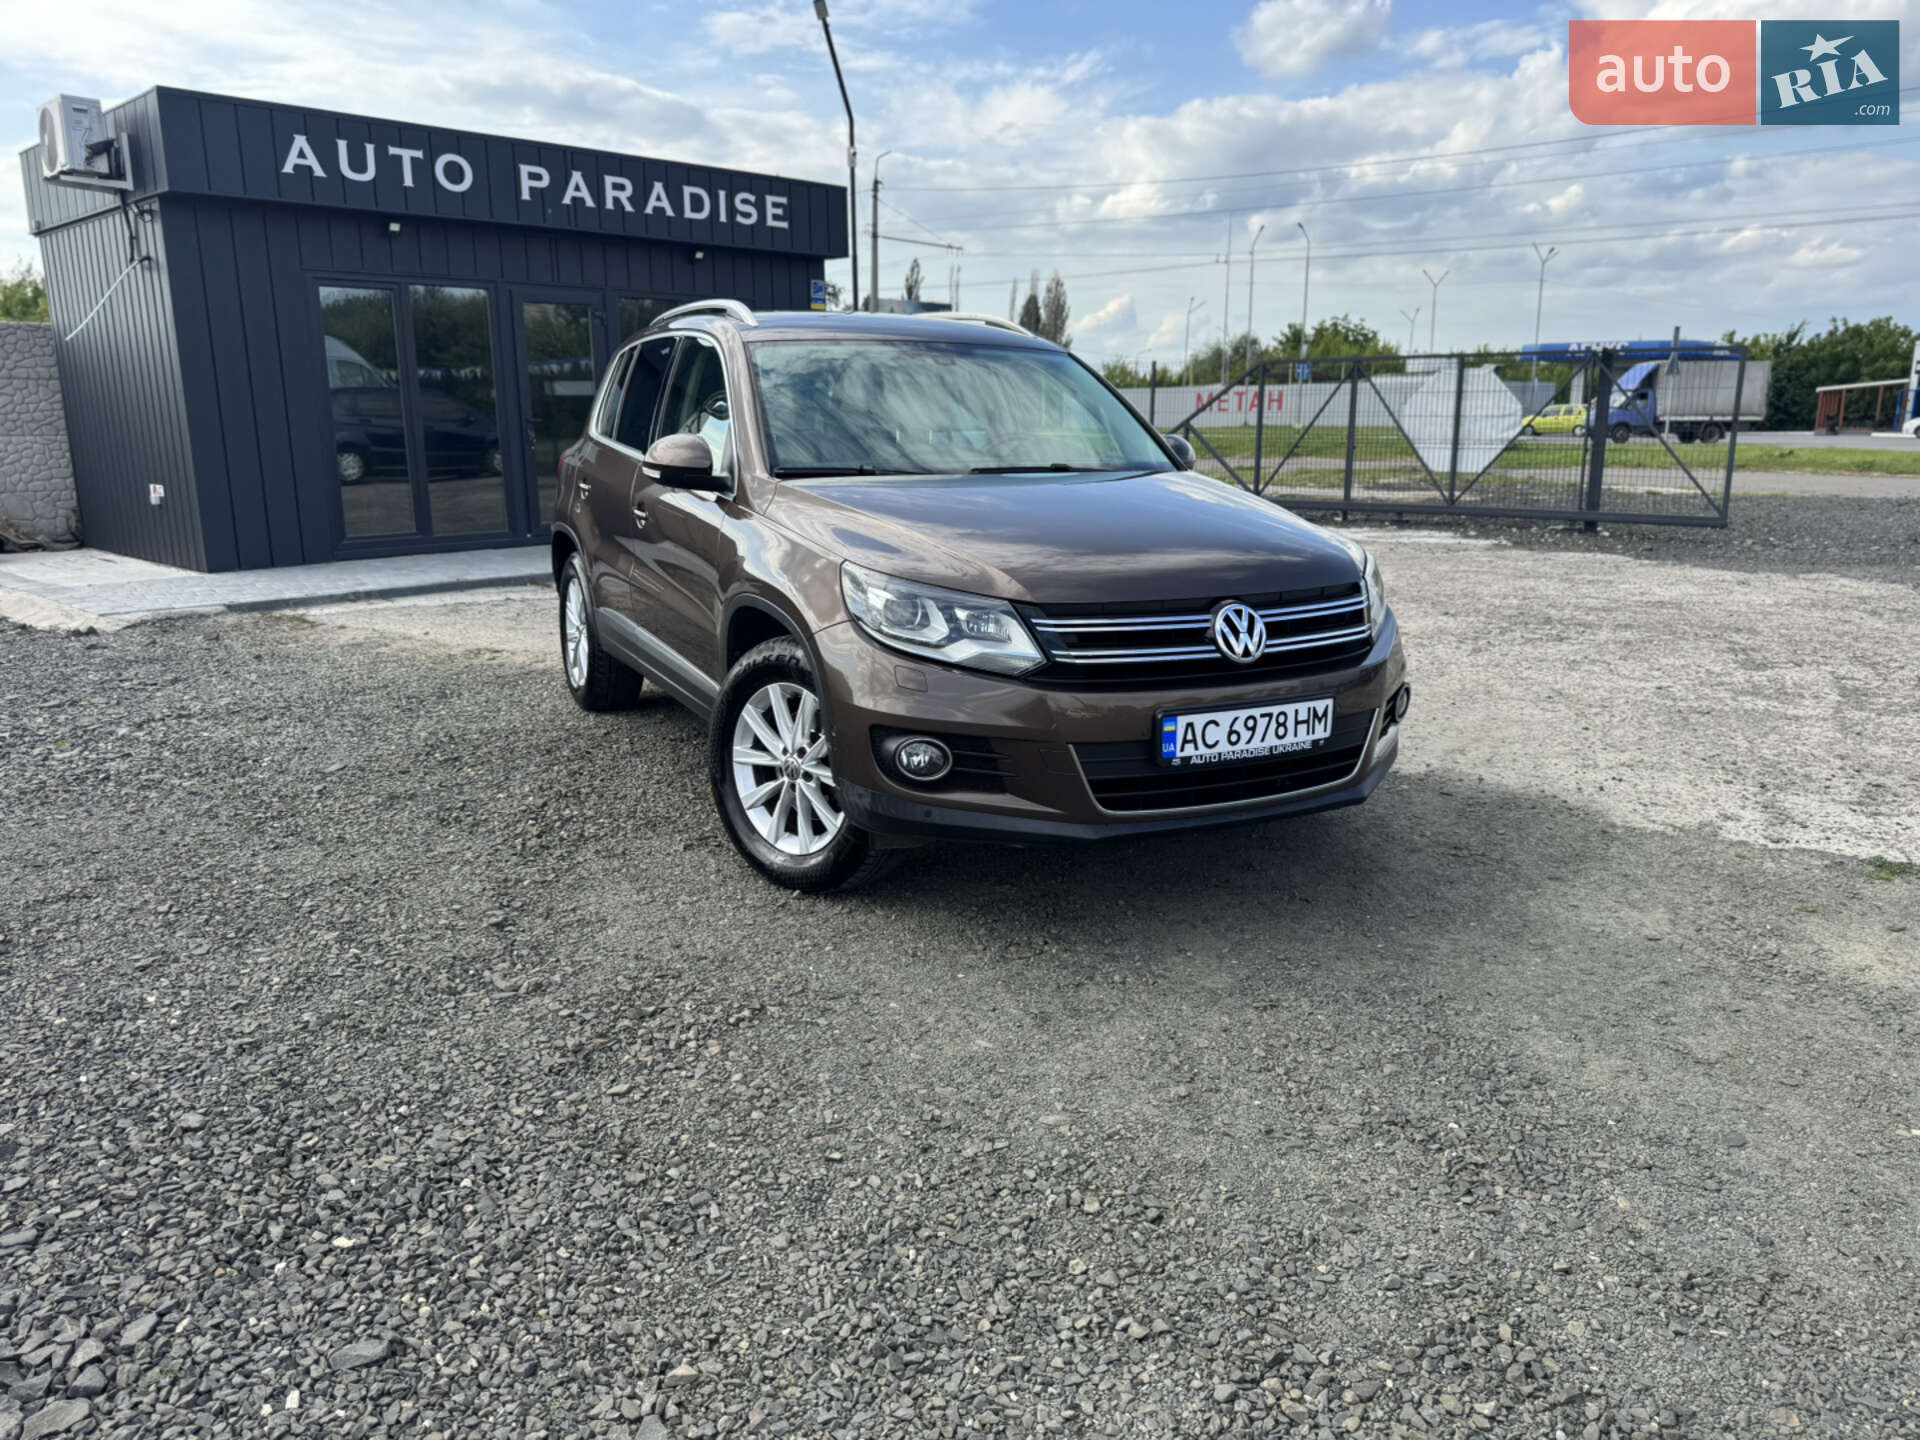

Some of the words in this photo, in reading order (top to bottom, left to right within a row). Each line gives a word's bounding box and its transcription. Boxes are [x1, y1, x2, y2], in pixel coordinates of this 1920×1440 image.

[280, 134, 474, 193] AUTO
[518, 163, 790, 230] PARADISE
[1179, 719, 1220, 753] AC
[1226, 711, 1289, 746] 6978
[1294, 704, 1329, 738] HM
[1190, 753, 1219, 765] AUTO
[1221, 746, 1270, 761] PARADISE
[1272, 740, 1313, 754] UKRAINE
